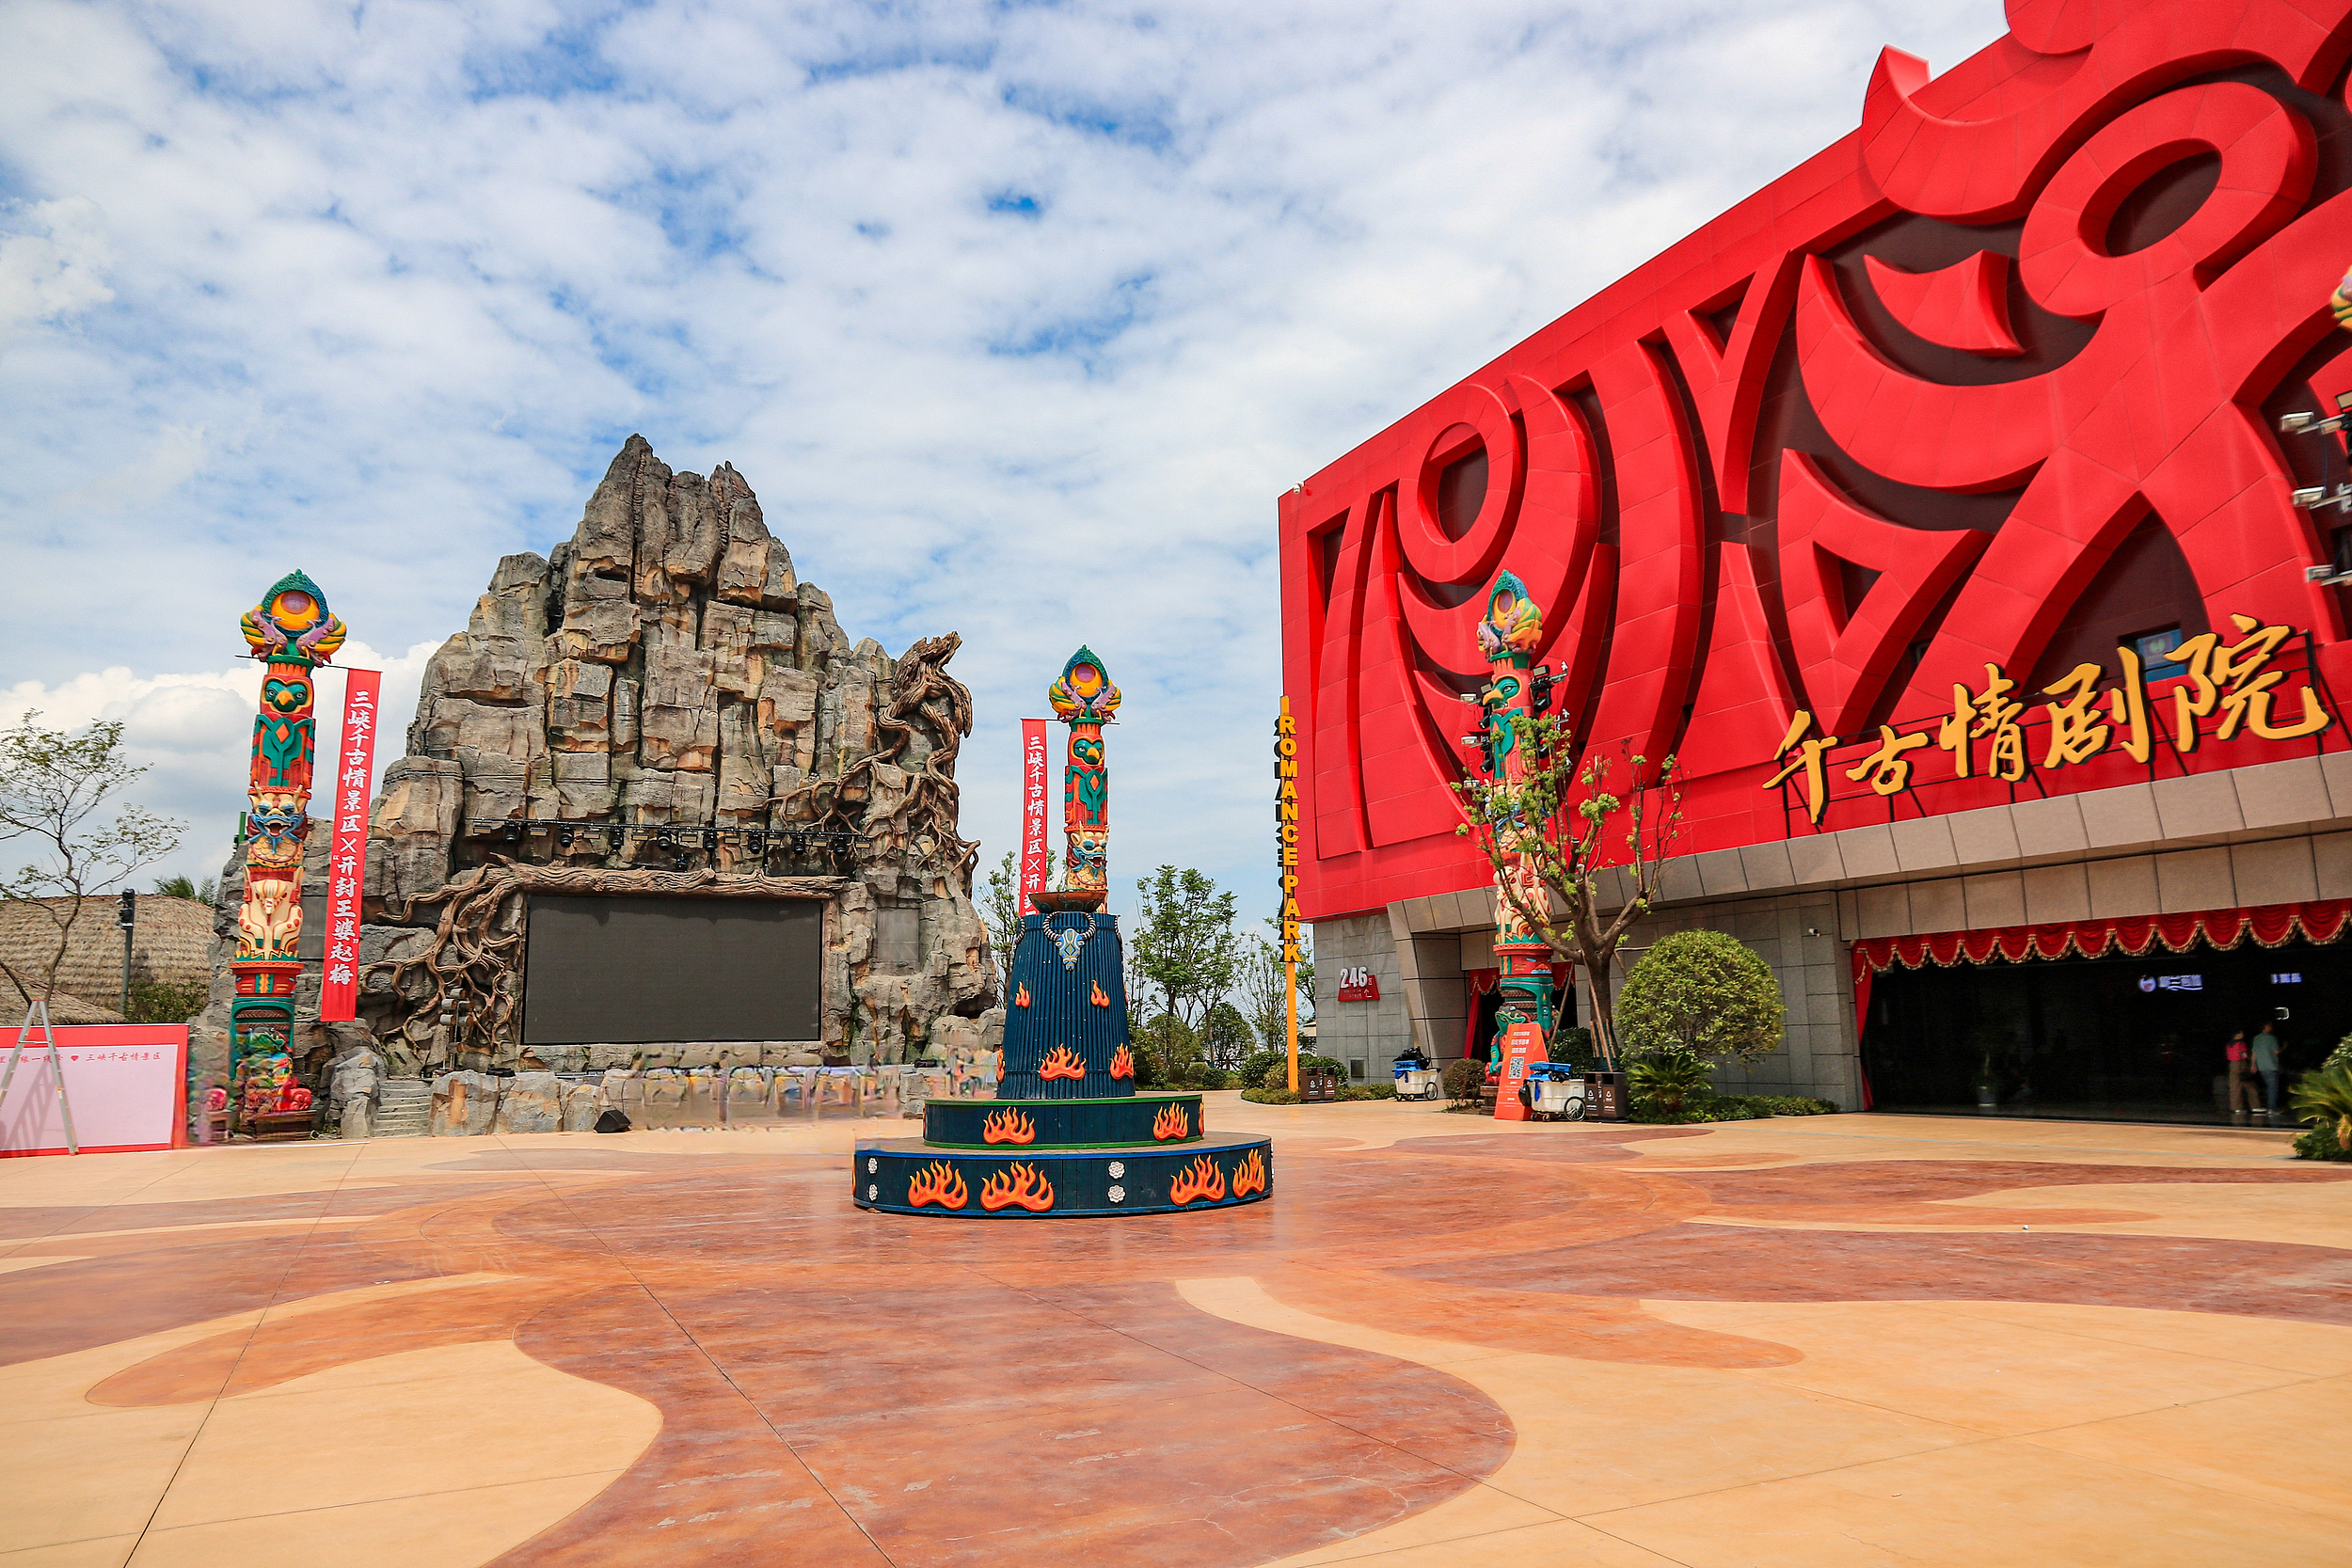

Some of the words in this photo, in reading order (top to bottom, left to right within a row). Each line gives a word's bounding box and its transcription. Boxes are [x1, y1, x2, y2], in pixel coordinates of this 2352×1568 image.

[1762, 613, 2329, 825] 千古情剧院
[1279, 715, 1300, 865] ROMANCE
[1283, 875, 1302, 962] PARK
[1340, 966, 1368, 988] 246
